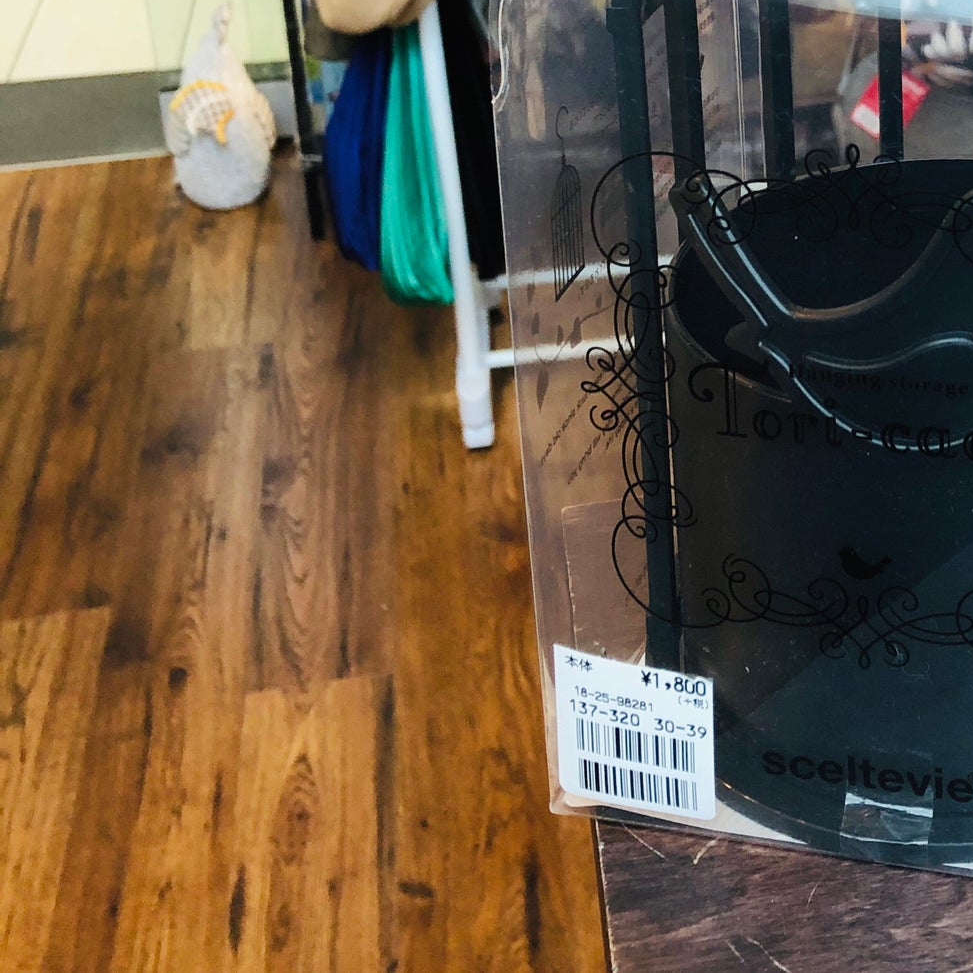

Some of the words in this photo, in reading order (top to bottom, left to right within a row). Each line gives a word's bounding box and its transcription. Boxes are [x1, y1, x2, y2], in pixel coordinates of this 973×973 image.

[888, 375, 969, 397] storage
[565, 654, 593, 672] 本体
[640, 670, 707, 696] ¥1,800
[574, 685, 654, 713] 18-25-98281
[569, 699, 641, 727] 137-320
[654, 718, 708, 739] 30-39
